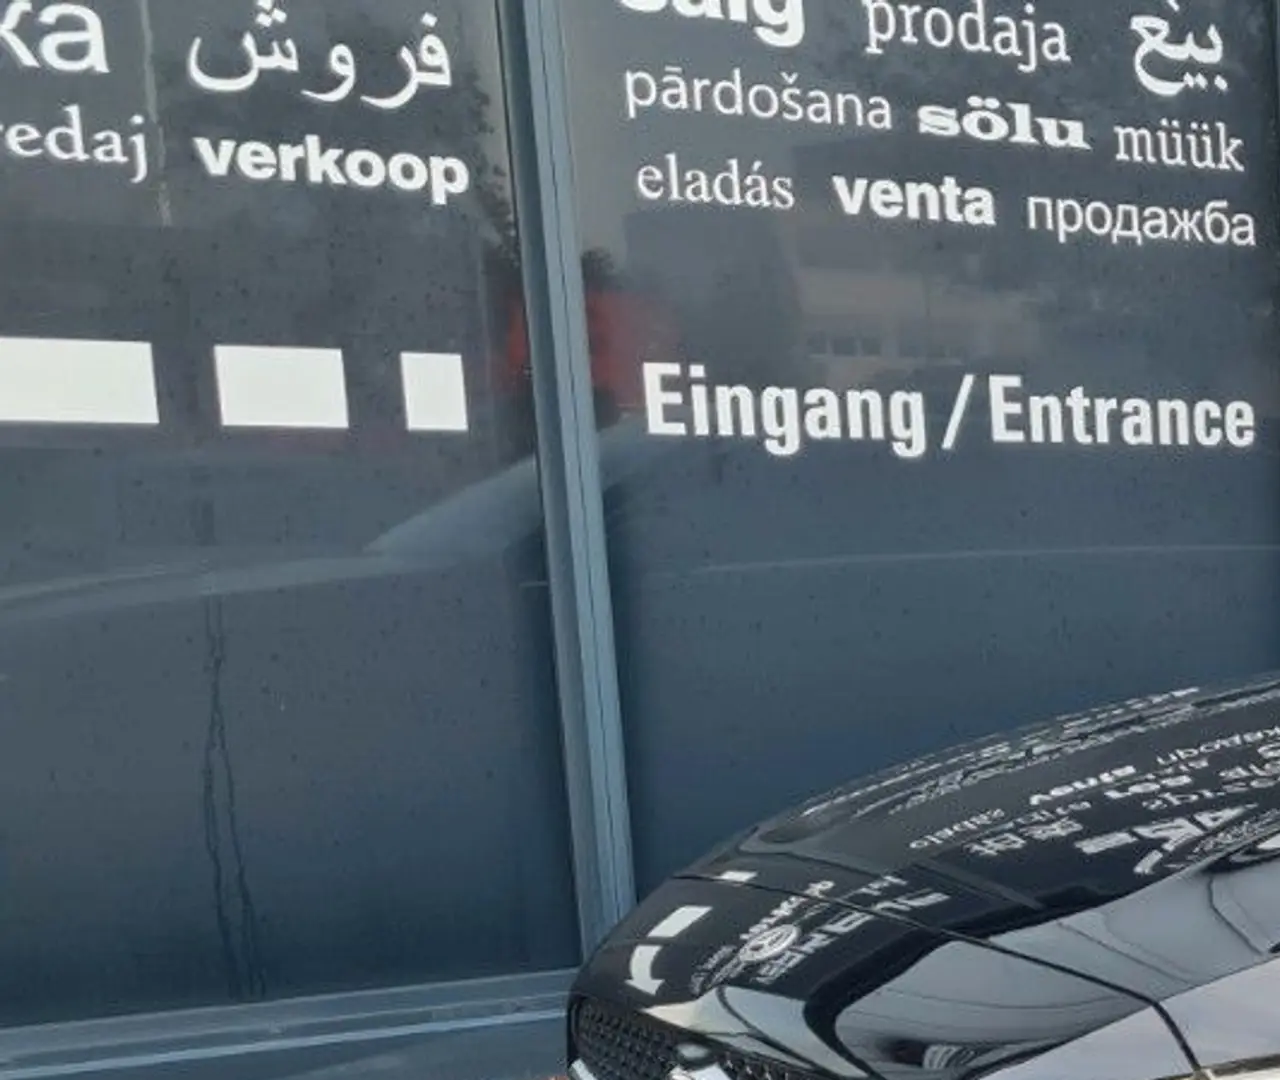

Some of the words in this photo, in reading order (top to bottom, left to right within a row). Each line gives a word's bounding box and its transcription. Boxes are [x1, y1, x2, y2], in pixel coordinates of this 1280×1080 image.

[863, 0, 1071, 72] prodaja
[0, 105, 148, 184] edaj
[193, 134, 469, 206] verkoop
[625, 67, 892, 130] pārdošana
[917, 95, 1091, 150] sölu
[1113, 118, 1245, 172] müük
[637, 153, 795, 209] eladás
[832, 175, 996, 227] venta
[1027, 196, 1256, 247] продажба
[642, 361, 927, 458] Eingang
[988, 374, 1256, 449] Entrance
